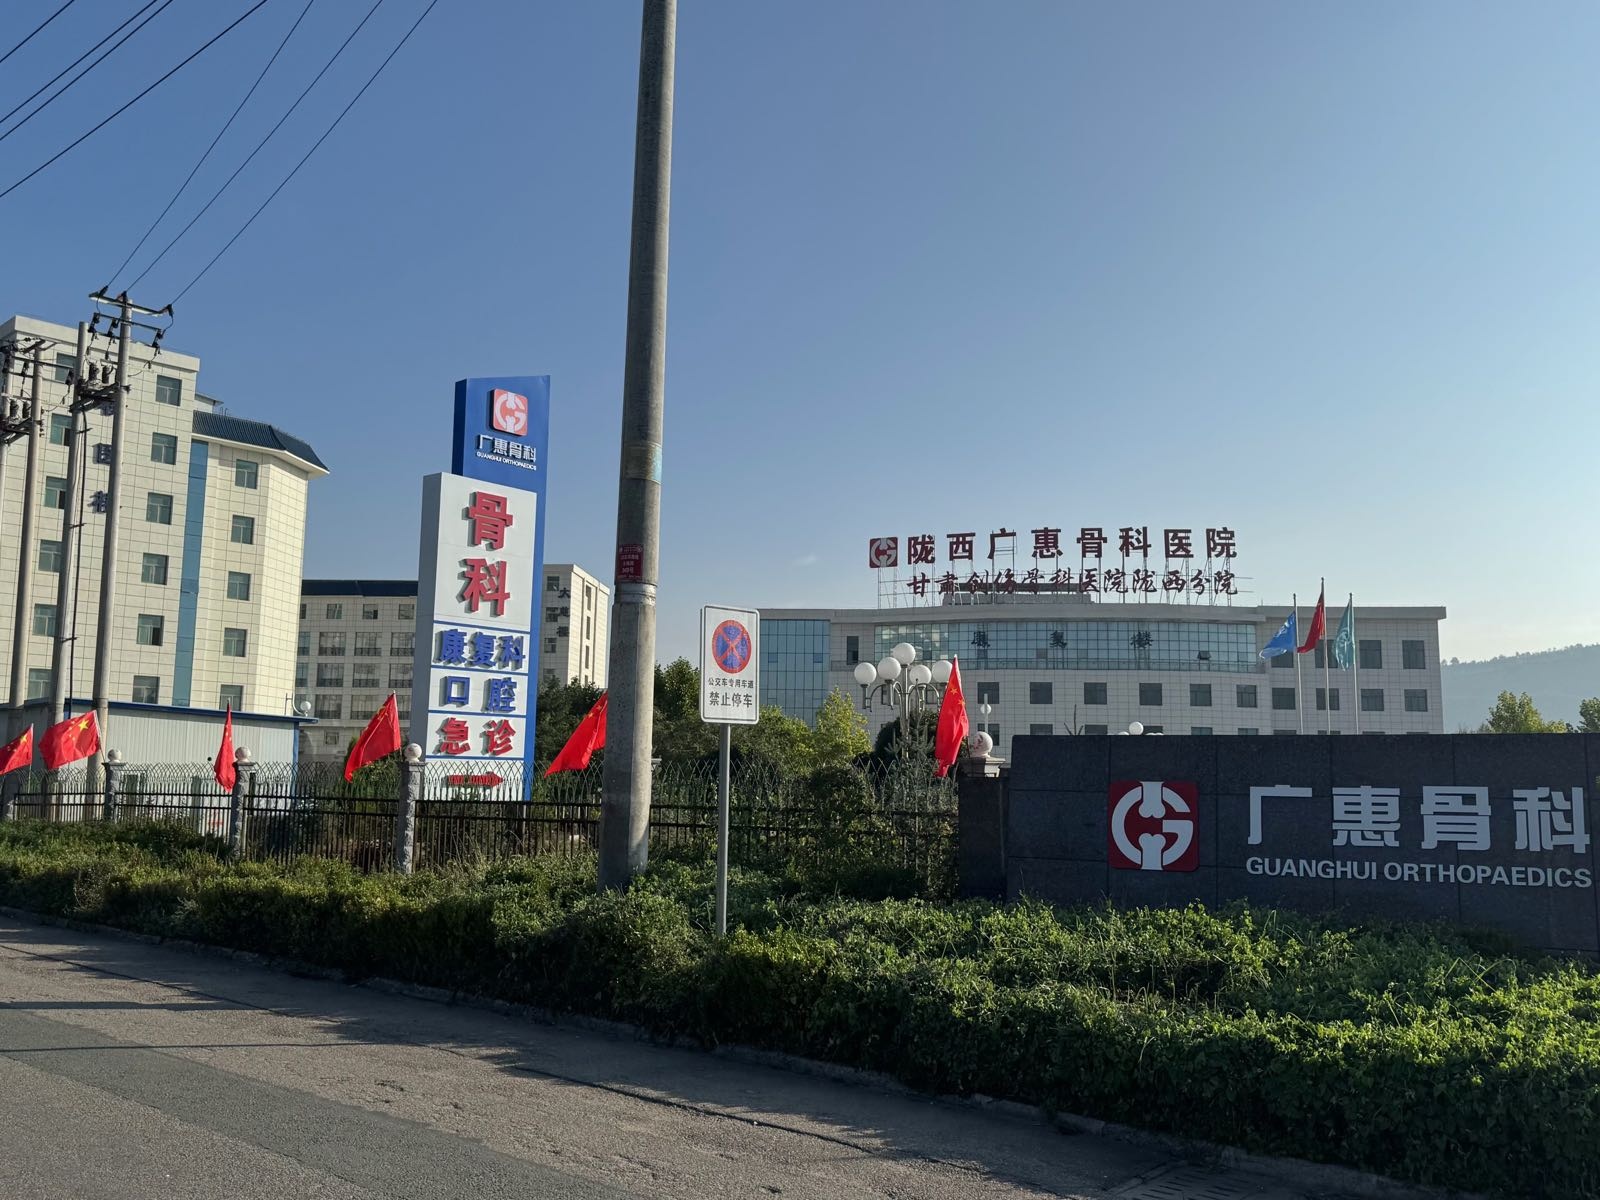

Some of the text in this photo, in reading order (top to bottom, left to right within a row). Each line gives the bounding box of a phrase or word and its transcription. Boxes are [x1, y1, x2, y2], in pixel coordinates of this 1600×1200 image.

[476, 451, 502, 462] GUANGHUI
[479, 434, 536, 462] 广惠骨科
[459, 491, 513, 616] 骨科
[908, 526, 1238, 565] 陇西广惠骨科医院
[435, 629, 526, 671] 康复科
[443, 676, 517, 713] 口腔
[709, 691, 753, 708] 禁止停车
[438, 717, 516, 756] 急诊
[1247, 784, 1590, 854] 广惠骨科
[1246, 856, 1592, 888] GUANGHUI ORTHOPAEDICS
